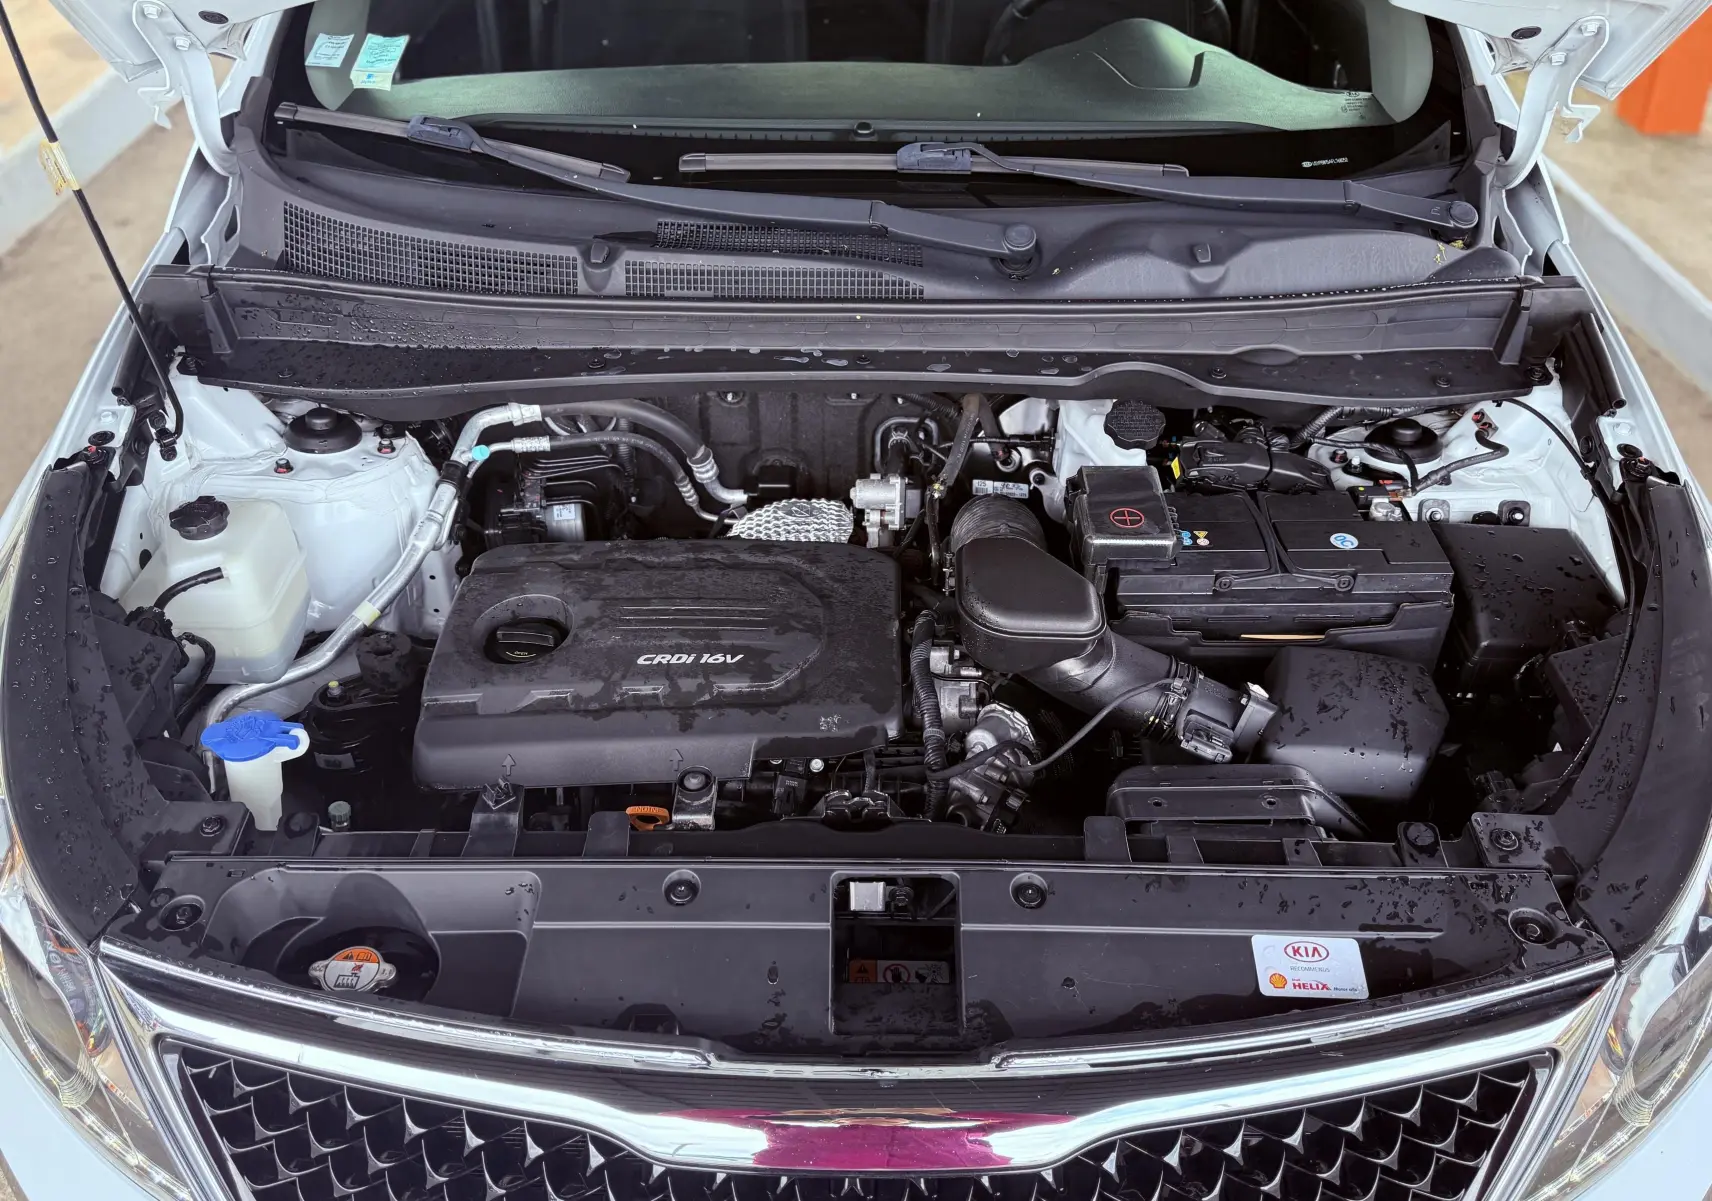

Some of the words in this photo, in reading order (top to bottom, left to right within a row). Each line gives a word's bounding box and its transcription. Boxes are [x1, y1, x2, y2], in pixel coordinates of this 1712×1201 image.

[637, 653, 697, 665] CRDi
[699, 653, 745, 664] 16V
[1291, 945, 1323, 958] KIA
[1292, 982, 1332, 991] HELIX
